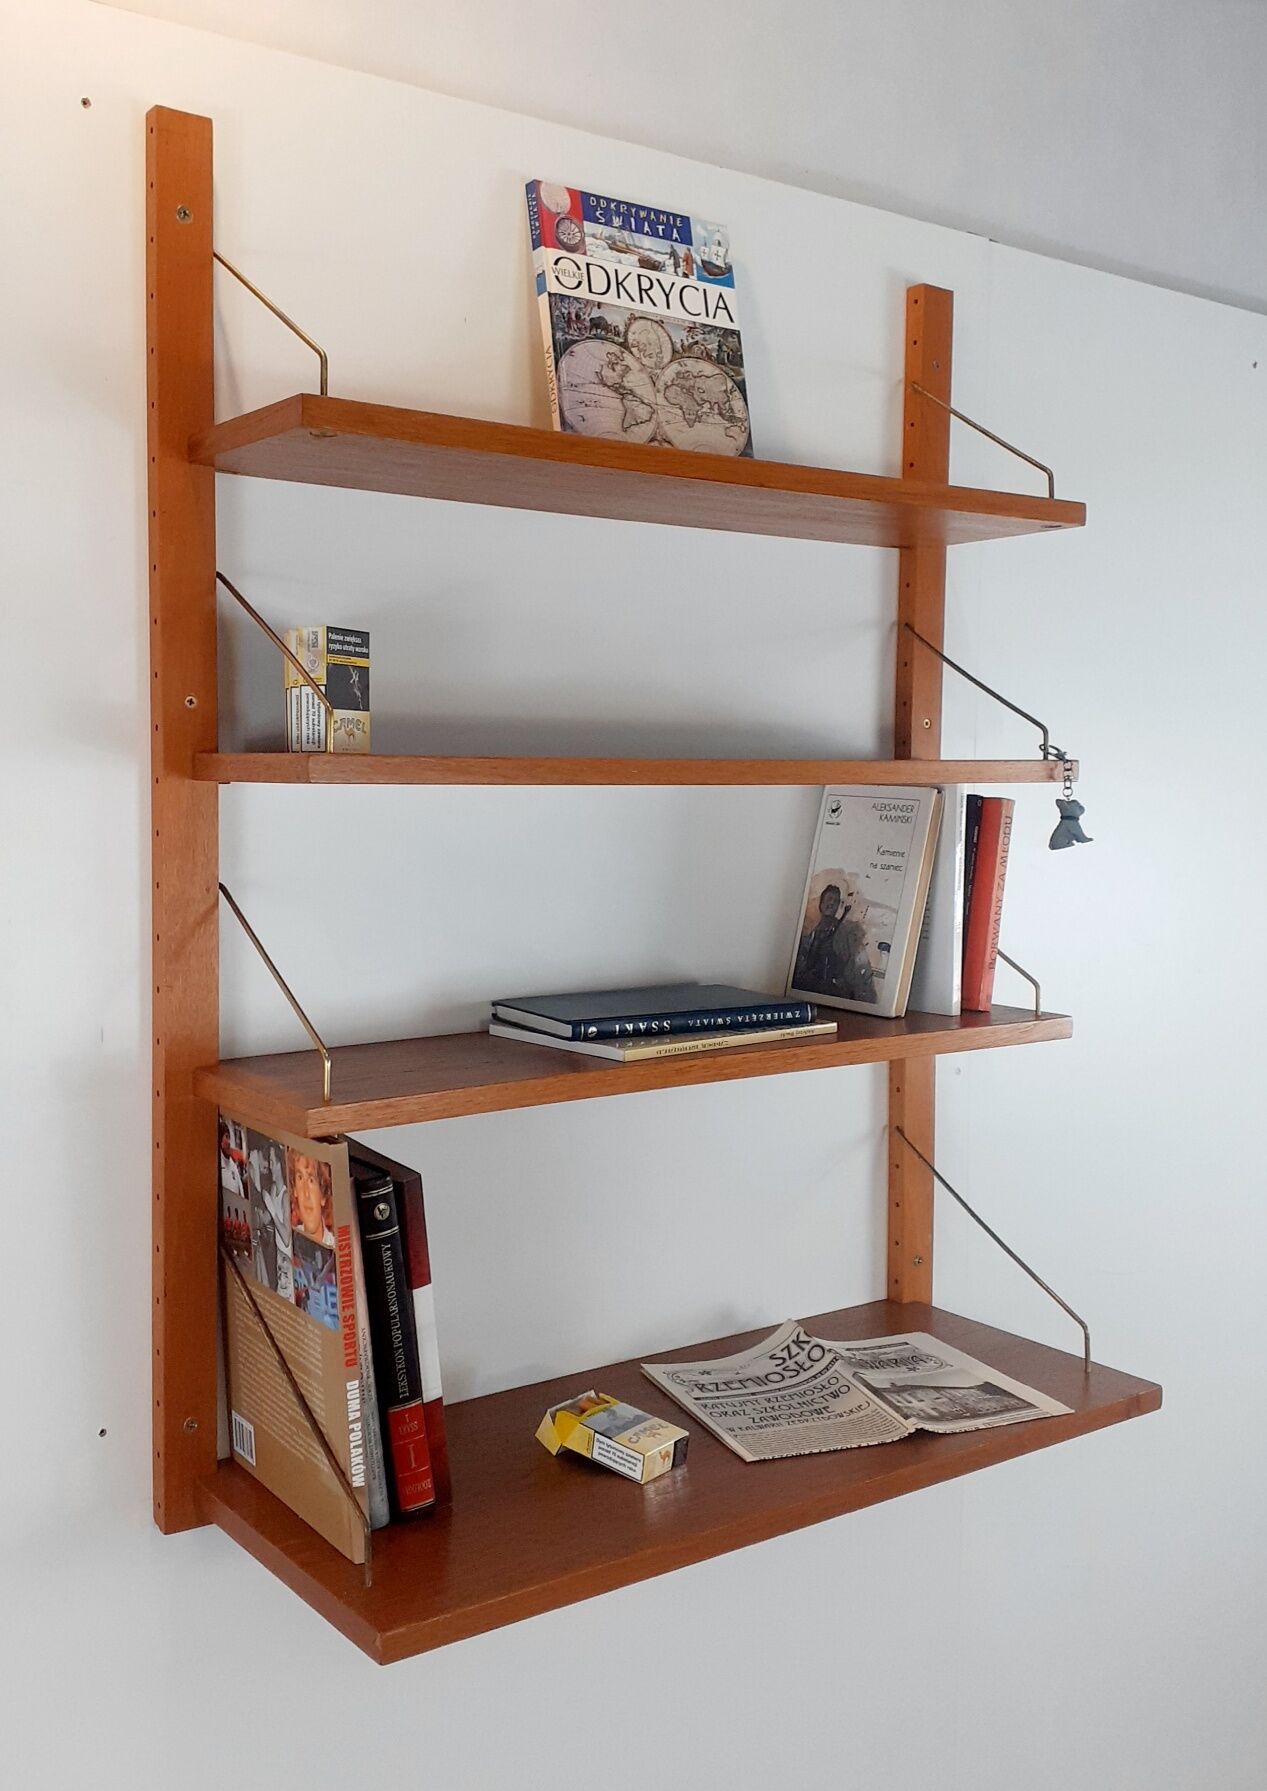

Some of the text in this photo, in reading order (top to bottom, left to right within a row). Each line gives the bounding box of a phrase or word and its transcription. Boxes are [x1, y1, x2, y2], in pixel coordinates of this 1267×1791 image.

[589, 197, 683, 226] ODKRYWANIE
[595, 207, 681, 242] ŚWIATA
[551, 266, 584, 281] WIELKIE
[553, 256, 735, 323] ODKRYCIA
[872, 802, 915, 814] ALEKSANDER
[988, 815, 1013, 970] PORWANY ZA MŁODU
[614, 1020, 671, 1035] SSAKI
[687, 1010, 801, 1027] ZWIERZĘTA ŚWIATA
[338, 1225, 366, 1488] MISTRZOWIE SPORTU DUMA POLAKÓW
[769, 1328, 812, 1367] SZK
[393, 1349, 409, 1399] LEKSYKON
[695, 1344, 826, 1394] RZEMIOSŁO
[709, 1384, 851, 1418] ORAZ SZKOLNICTWO
[764, 1376, 840, 1404] RZEMIOSŁO
[751, 1405, 835, 1424] ZAWODOWE
